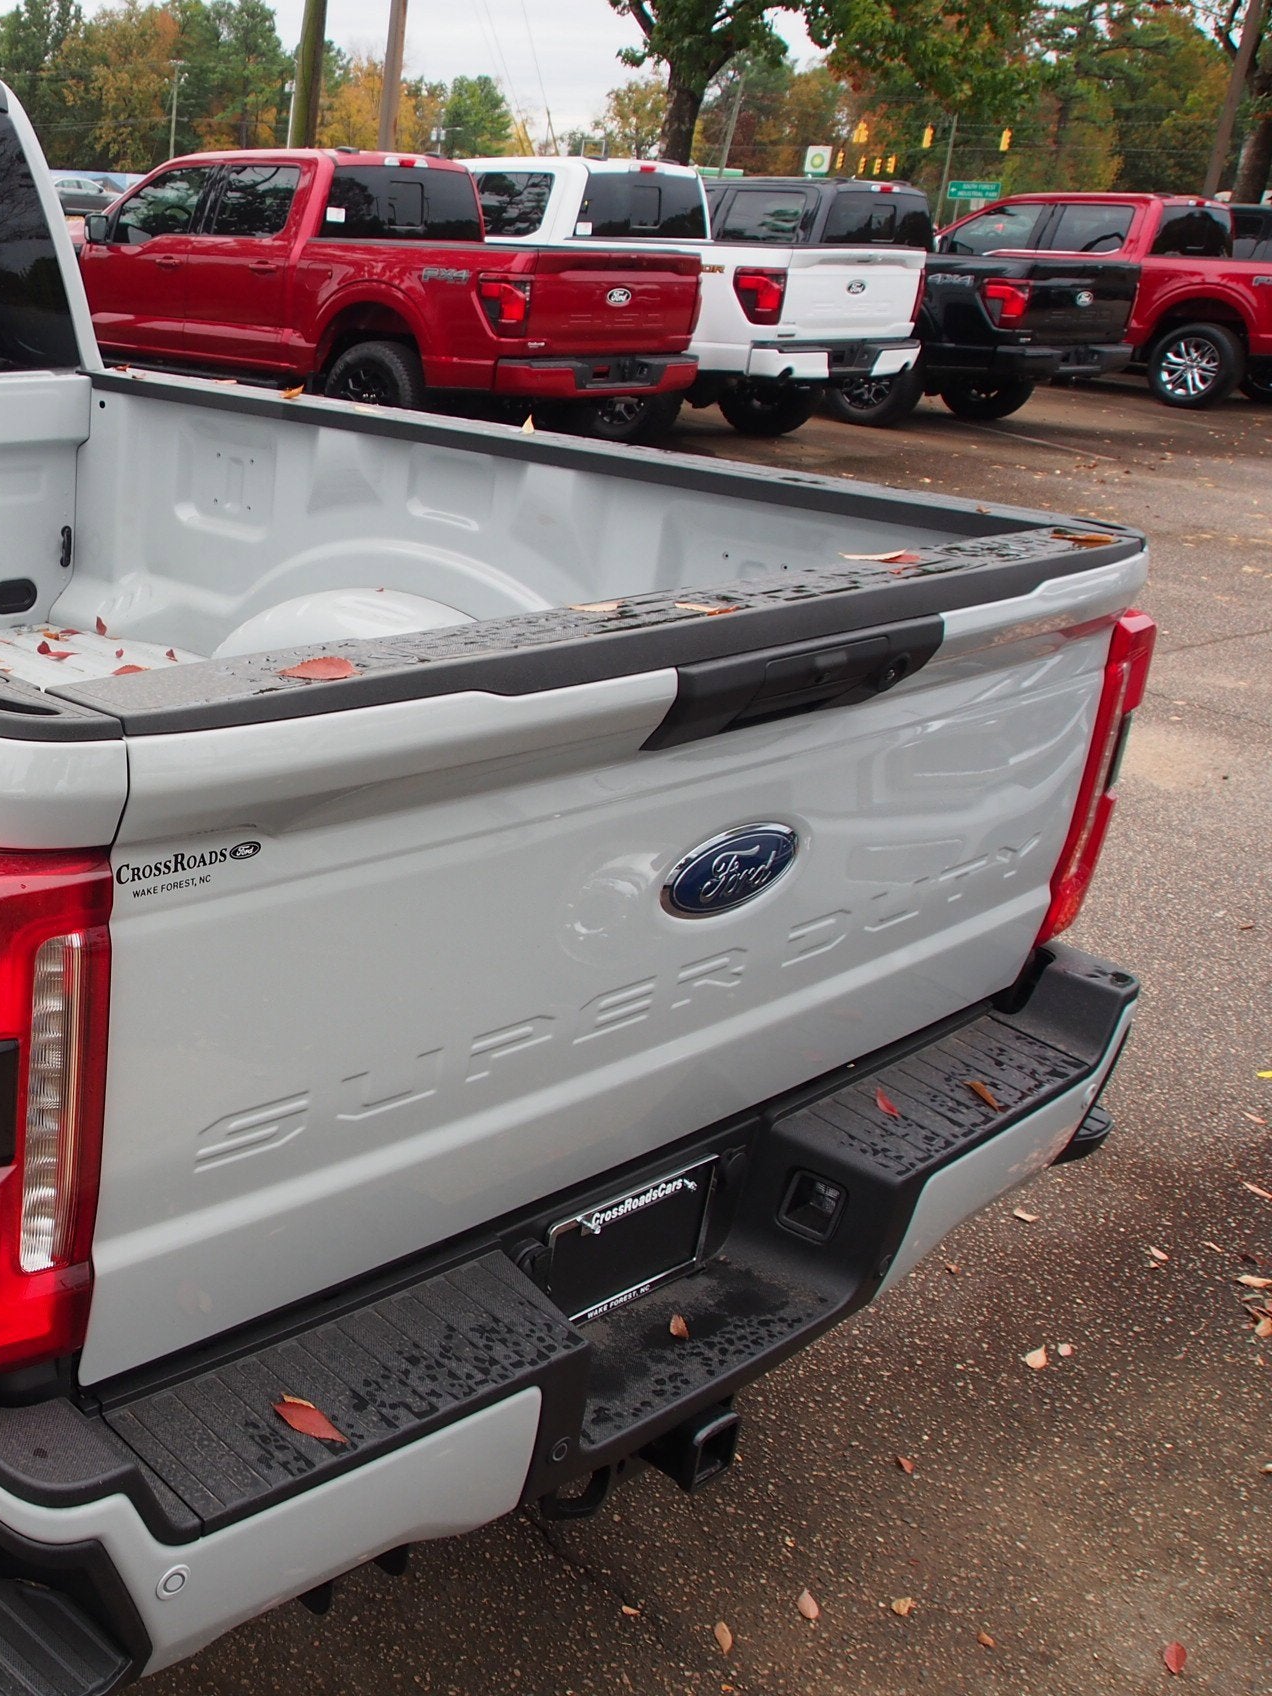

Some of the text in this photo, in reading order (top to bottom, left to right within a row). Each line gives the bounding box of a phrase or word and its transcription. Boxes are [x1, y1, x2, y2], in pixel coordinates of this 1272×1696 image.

[132, 874, 212, 898] WAKE FOREST, NC
[699, 844, 777, 904] Ford
[193, 830, 1042, 1175] SUPER DUTY
[591, 1177, 684, 1227] CrossRoadsCars
[587, 1284, 651, 1319] WAKE FOREST, NC
